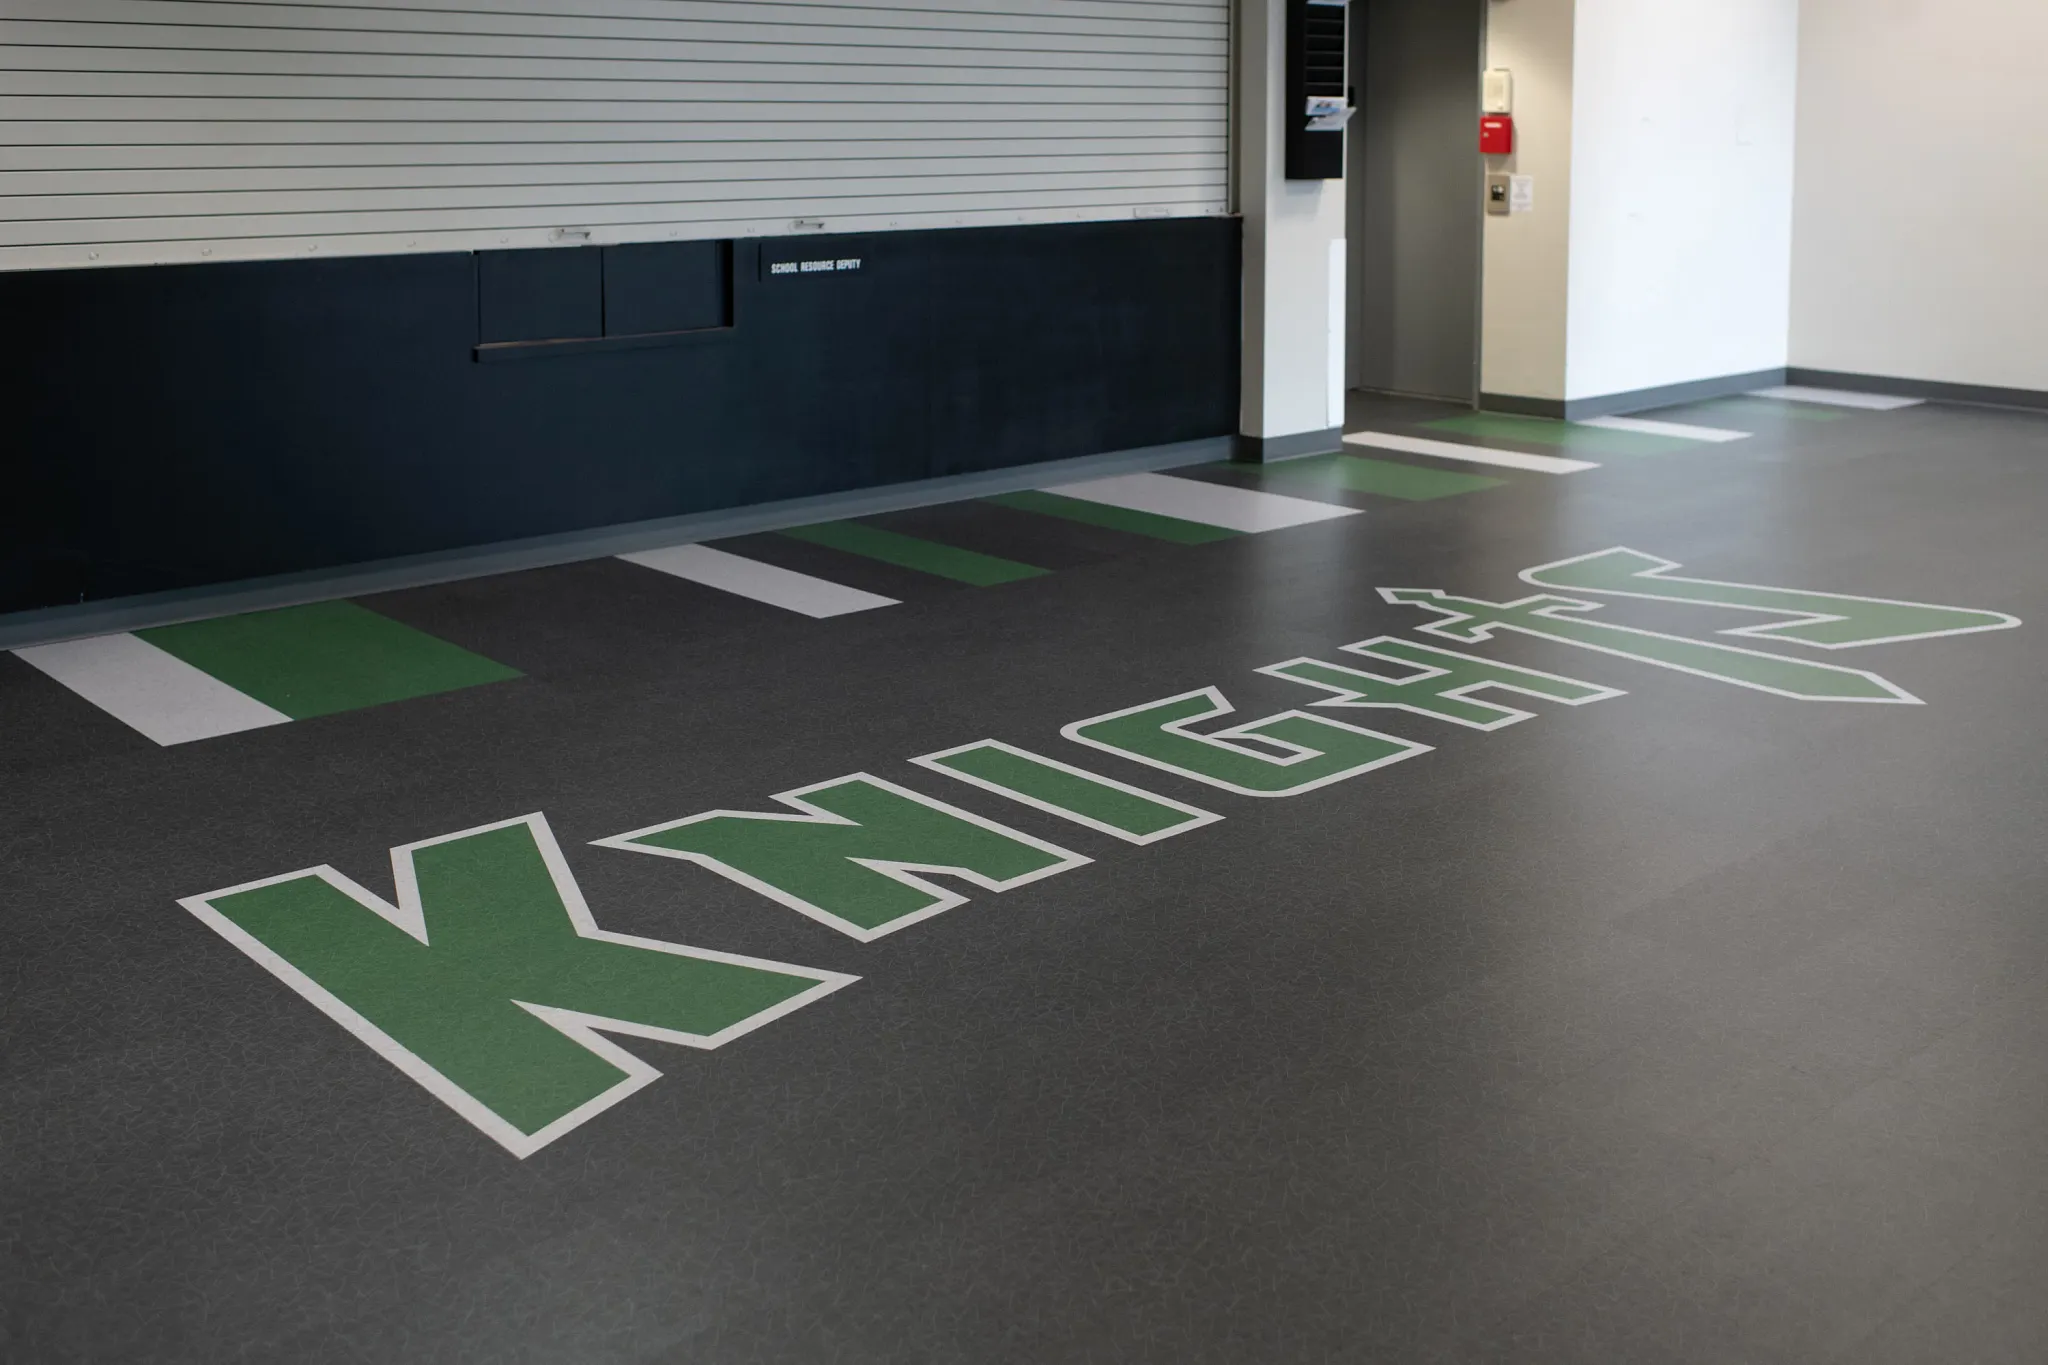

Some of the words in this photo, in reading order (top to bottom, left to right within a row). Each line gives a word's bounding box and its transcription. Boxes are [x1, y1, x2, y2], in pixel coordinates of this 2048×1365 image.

[771, 262, 798, 274] SCHOOL
[800, 260, 834, 272] RESOURCE
[836, 258, 861, 270] DEPUTY
[175, 546, 2022, 1160] KNIGHTS
